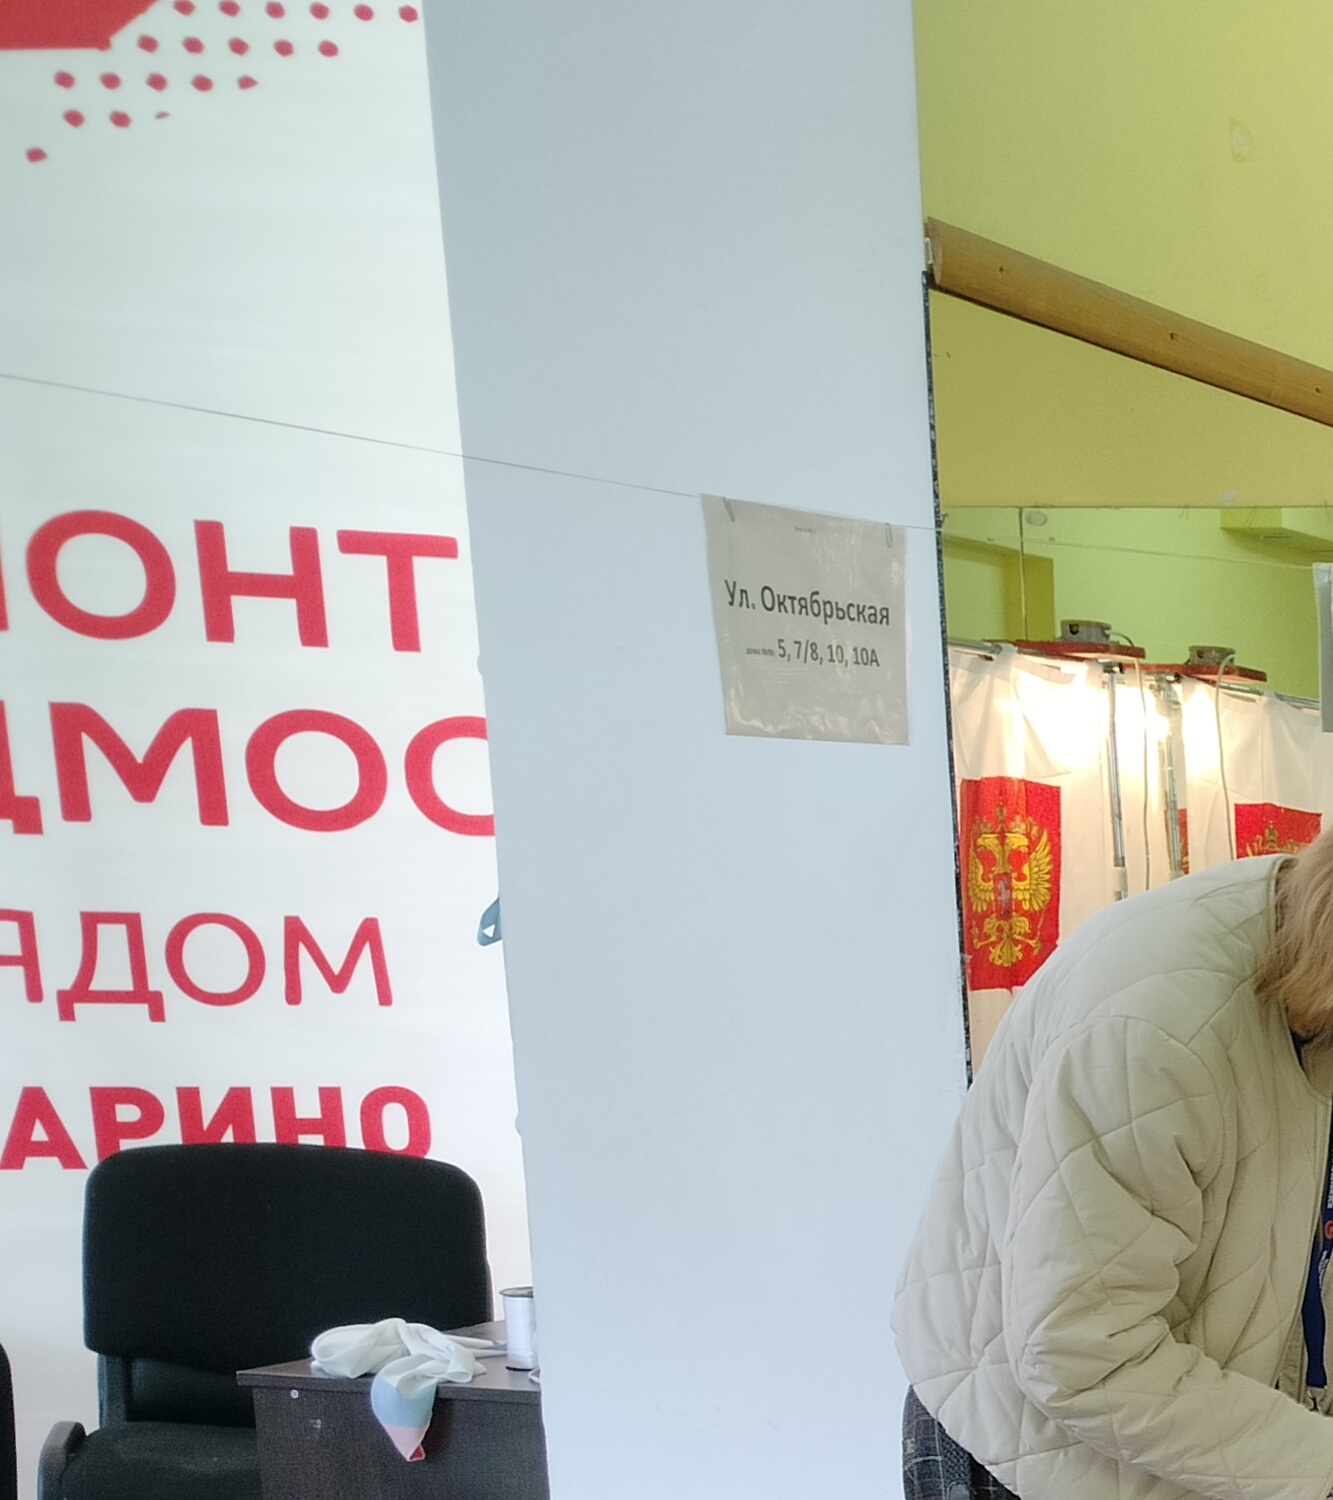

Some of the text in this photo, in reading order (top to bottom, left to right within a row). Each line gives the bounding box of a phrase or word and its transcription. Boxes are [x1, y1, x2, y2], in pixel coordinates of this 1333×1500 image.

[0, 508, 459, 653] ОНТ
[723, 579, 891, 626] Ул. Октябрьская
[777, 638, 791, 662] 5,
[793, 639, 823, 665] 7/8,
[827, 644, 849, 668] 10,
